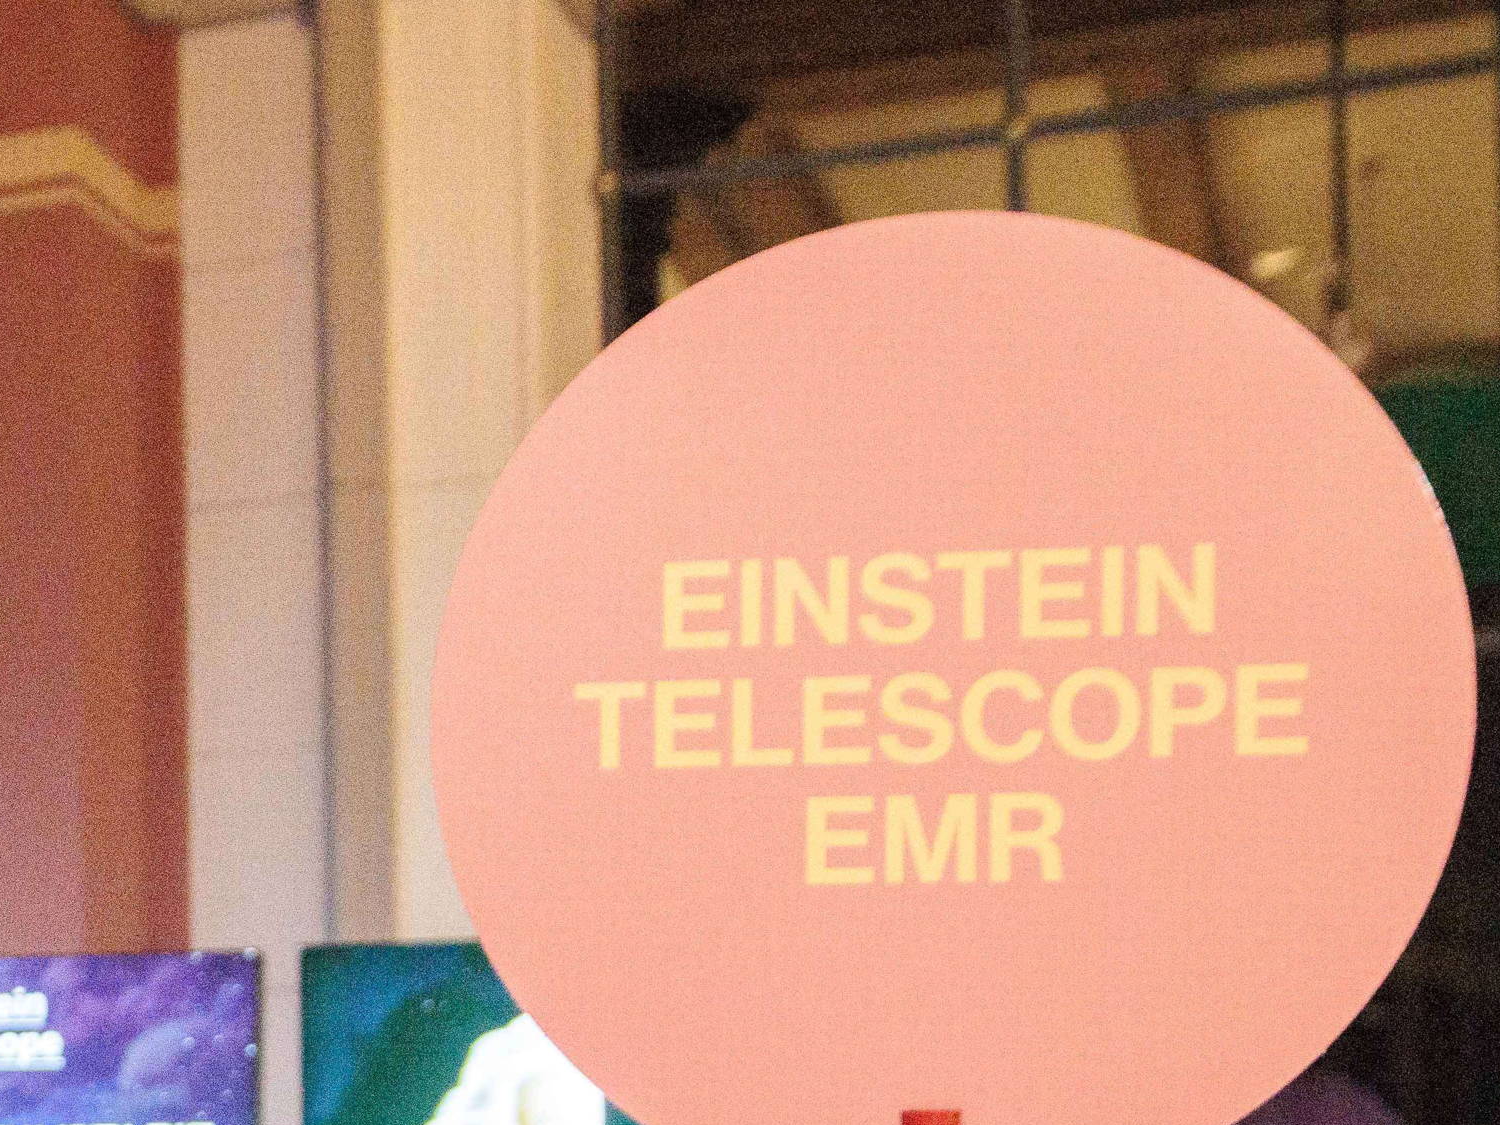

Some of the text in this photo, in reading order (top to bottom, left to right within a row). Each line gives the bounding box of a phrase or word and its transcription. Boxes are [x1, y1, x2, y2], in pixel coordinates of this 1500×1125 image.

[662, 542, 1216, 651] EINSTEIN
[572, 663, 1309, 769] TELESCOPE
[804, 791, 1065, 886] EMR
